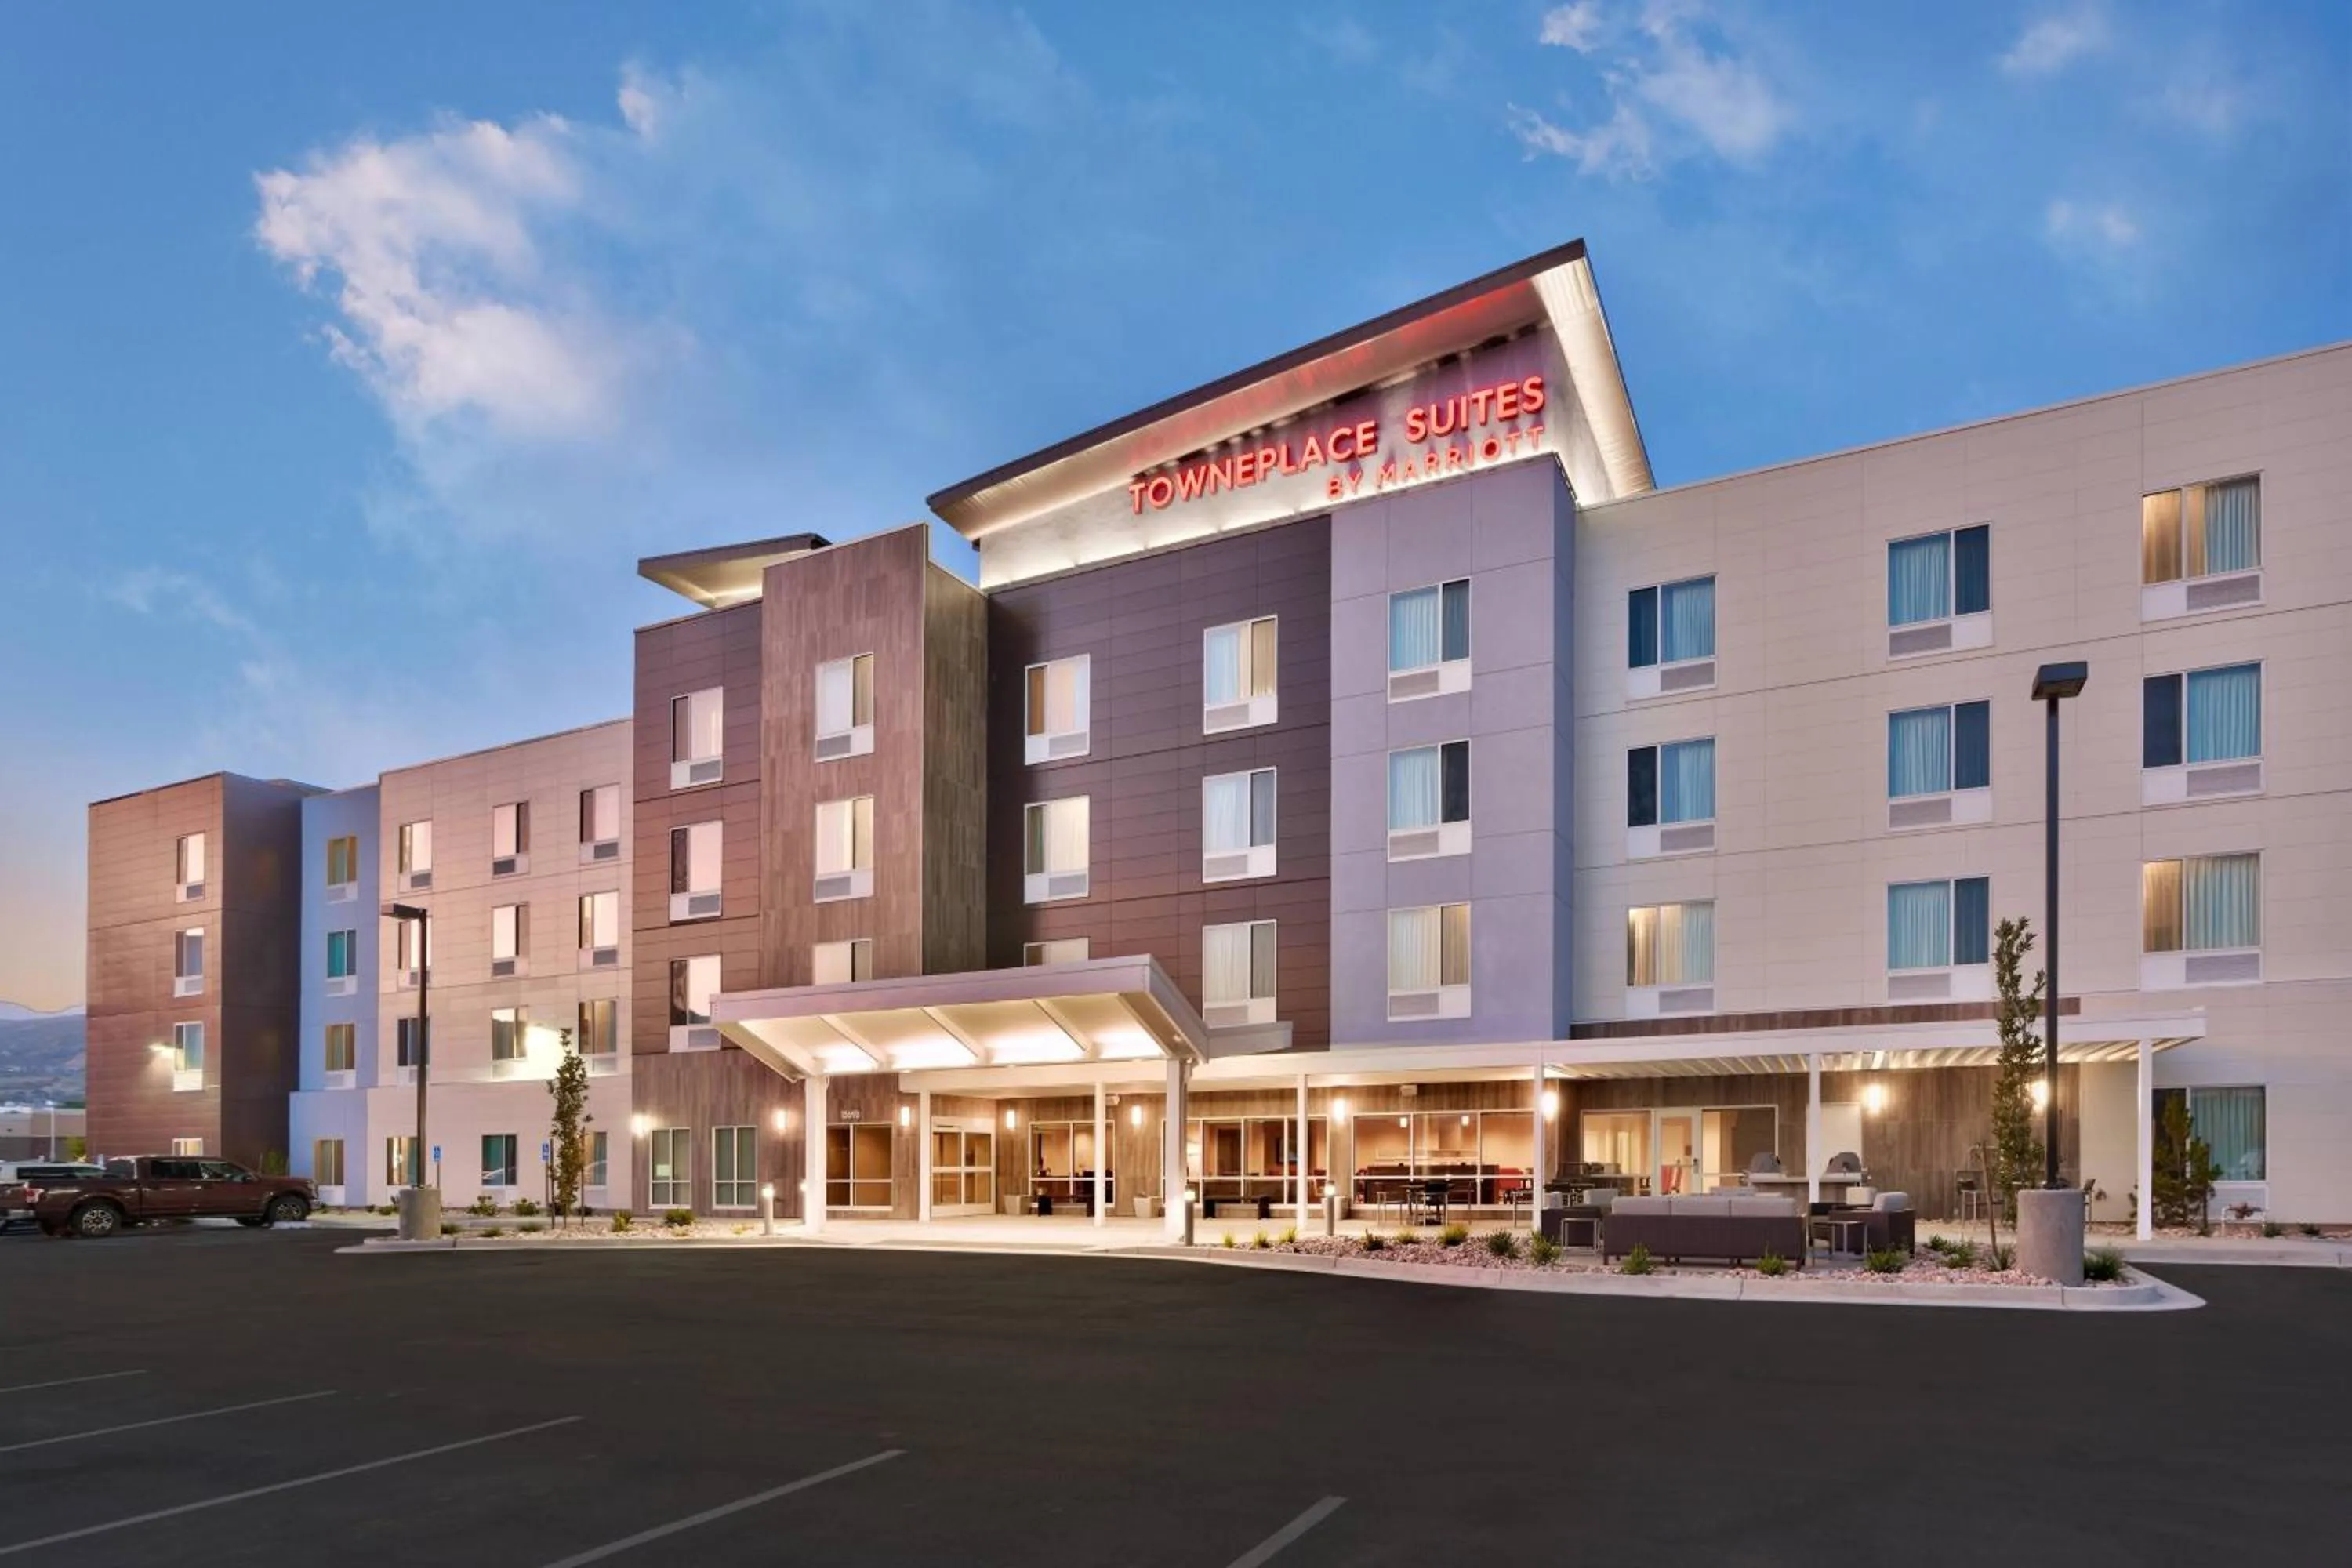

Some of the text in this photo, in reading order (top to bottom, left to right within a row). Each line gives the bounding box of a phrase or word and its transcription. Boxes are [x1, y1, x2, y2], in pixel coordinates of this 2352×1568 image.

[1128, 376, 1545, 514] TOWNEPLACE SUITES
[1327, 425, 1544, 500] BY MARRIOTT
